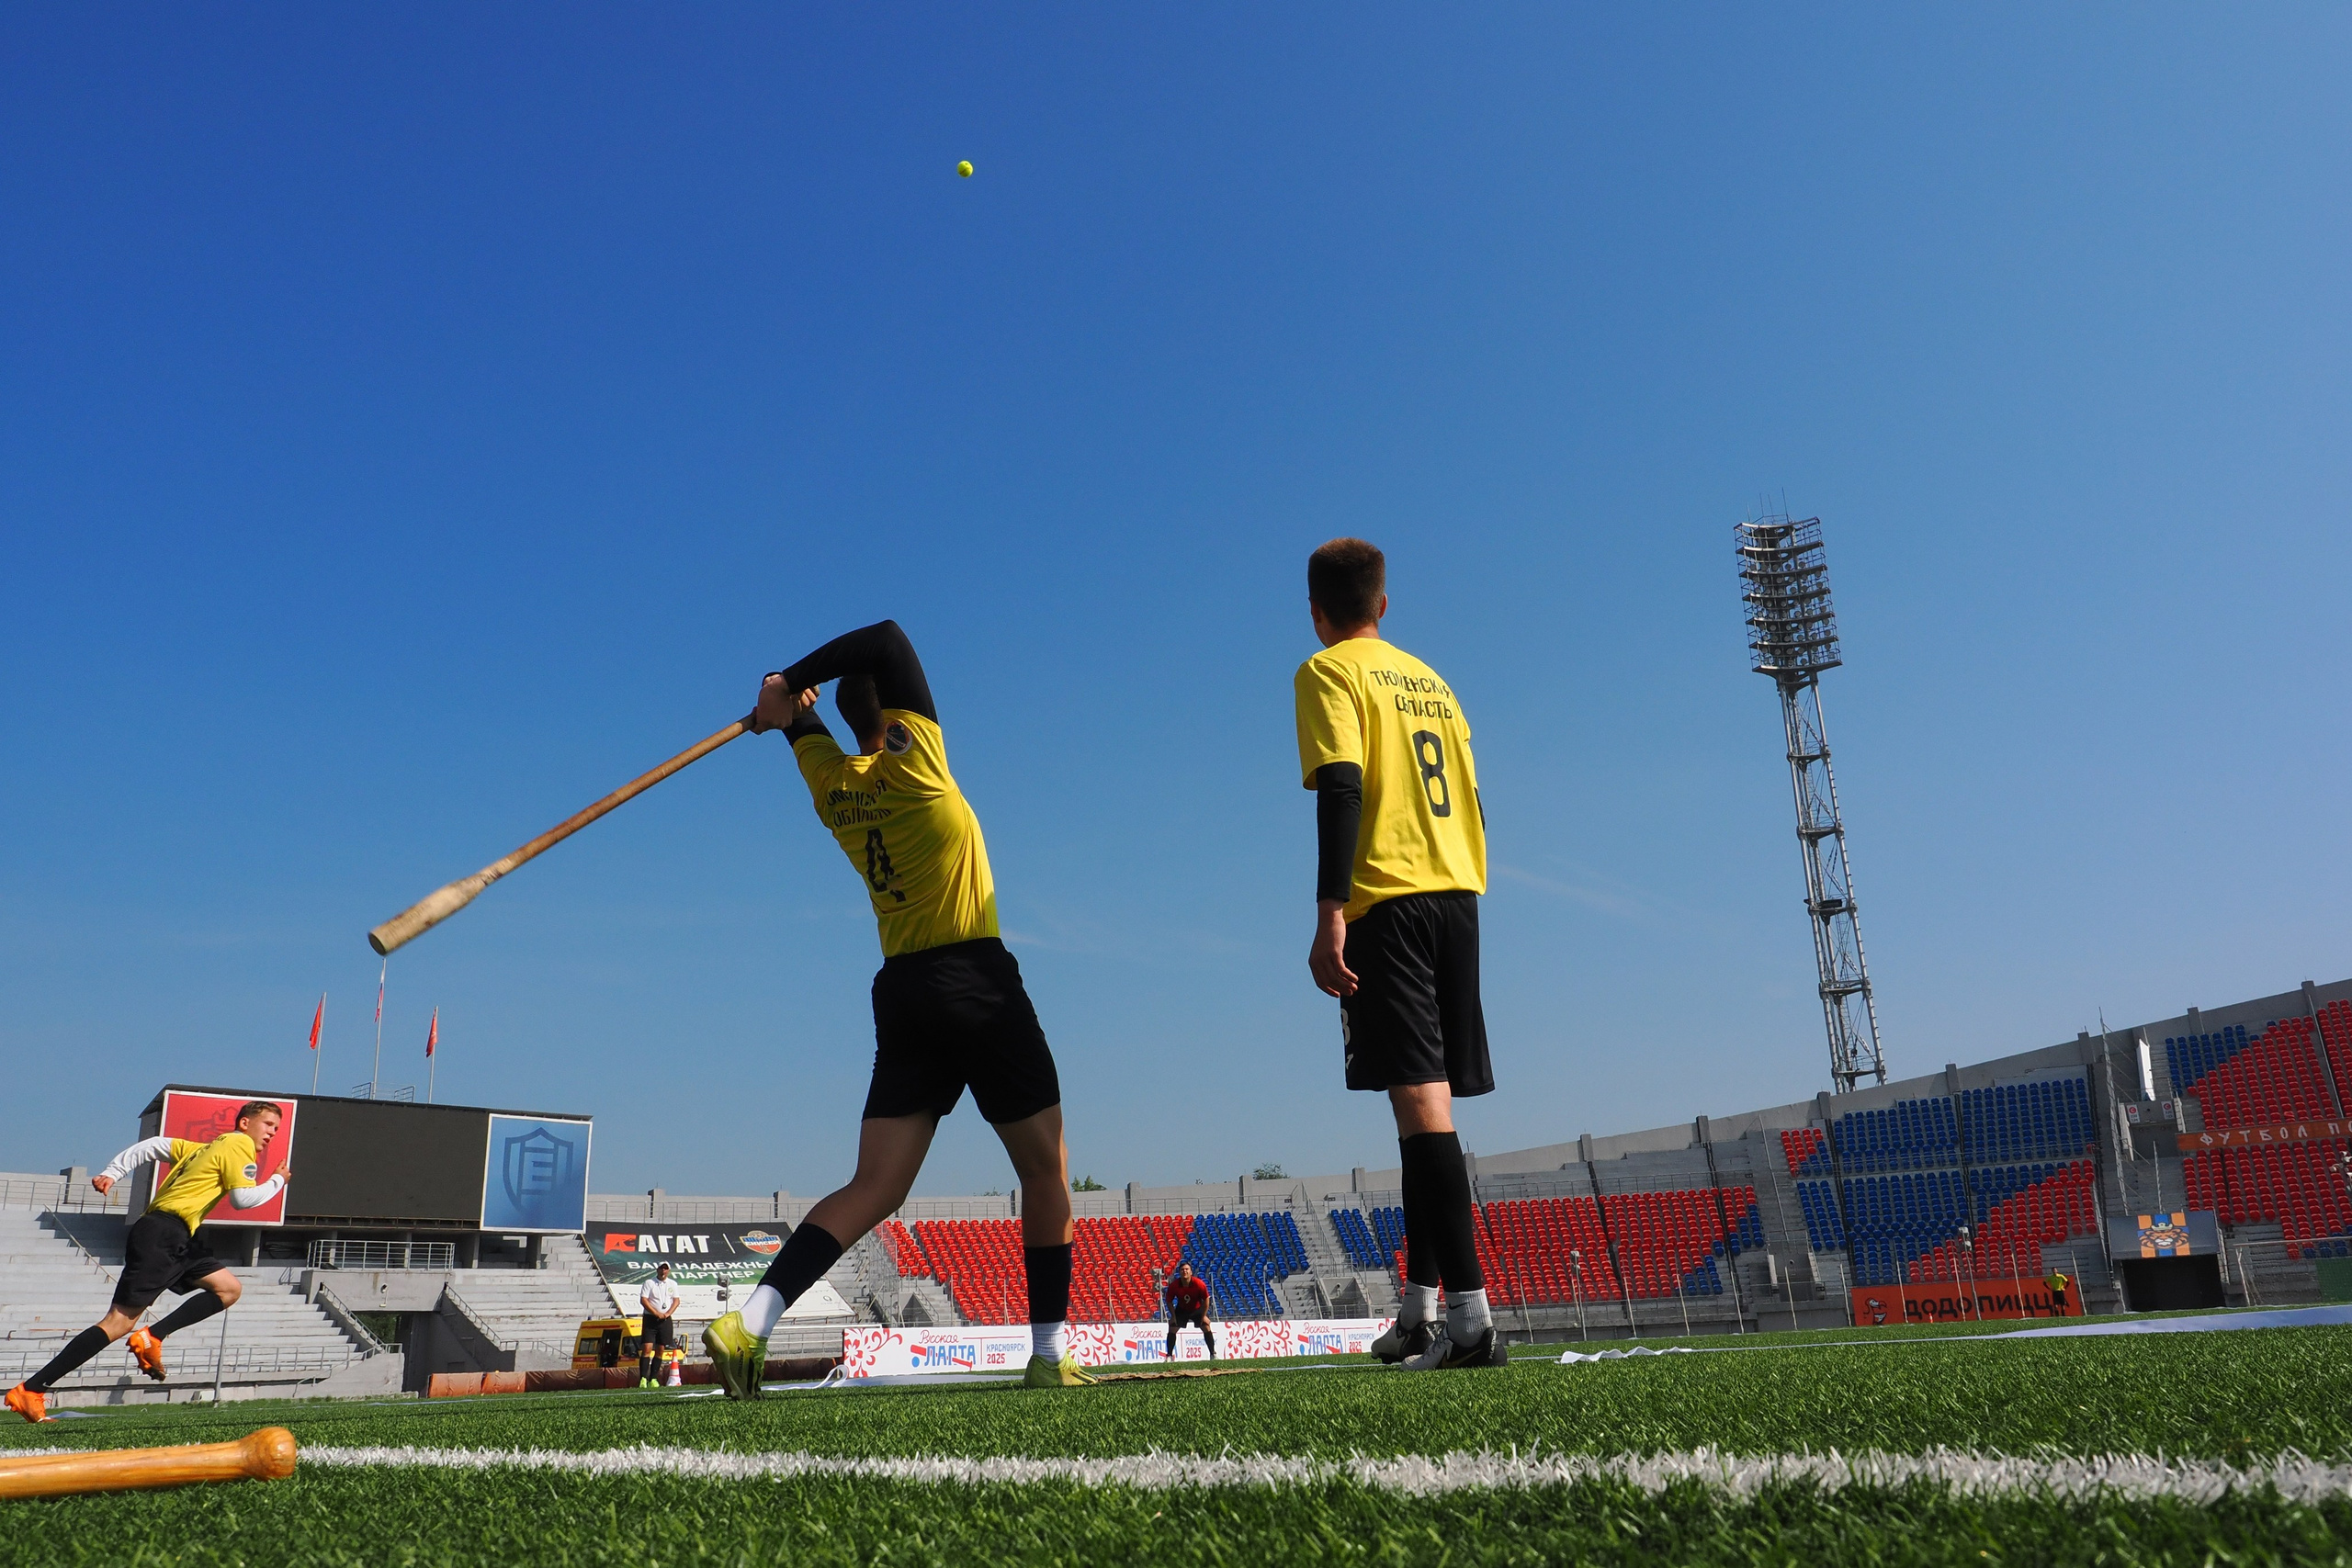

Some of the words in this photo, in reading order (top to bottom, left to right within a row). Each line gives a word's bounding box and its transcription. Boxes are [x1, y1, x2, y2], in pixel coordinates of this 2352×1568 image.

[1412, 729, 1452, 818] 8
[2199, 1124, 2308, 1146] ФУТБОЛ
[638, 1234, 710, 1254] АГАТ
[674, 1260, 773, 1270] НАДЕЖНЫ
[671, 1270, 756, 1280] ПАРТНЕР
[1183, 1294, 1191, 1303] 9
[1905, 1296, 1973, 1320] ДОДО
[1977, 1292, 2070, 1317] ПИЦЦ
[1348, 1333, 1375, 1341] КРАСНОЯРСК
[986, 1343, 1026, 1352] КРАСНОЯРСК
[1308, 1335, 1343, 1355] ЛАПТА
[1349, 1341, 1363, 1353] 2025
[924, 1344, 976, 1367] ЛАПТА
[987, 1353, 1006, 1364] 2025
[1186, 1347, 1202, 1359] 2025
